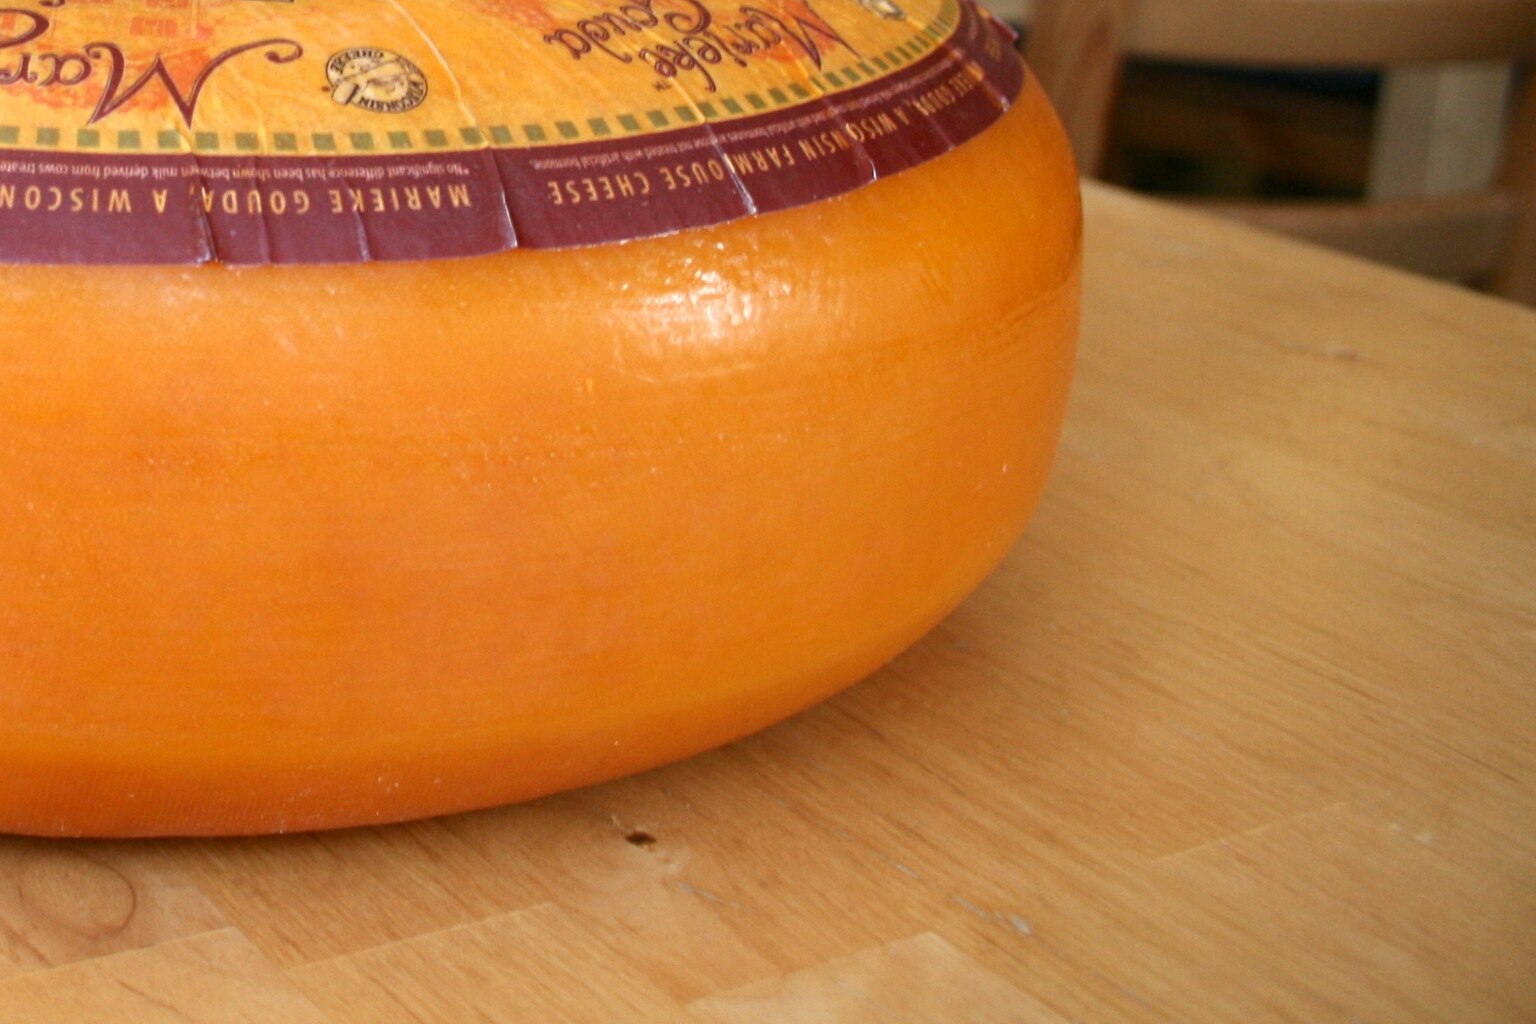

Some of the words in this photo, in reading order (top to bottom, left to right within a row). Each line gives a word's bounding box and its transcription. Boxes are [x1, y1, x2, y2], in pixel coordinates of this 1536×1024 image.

[38, 163, 69, 176] cows
[71, 164, 101, 180] from
[103, 164, 149, 180] derived
[151, 166, 178, 181] milk
[232, 167, 271, 182] shown
[272, 167, 305, 182] been
[304, 167, 327, 182] has
[328, 166, 385, 182] difference
[387, 160, 445, 180] significant
[658, 144, 796, 191] FARMOUSE
[547, 172, 651, 205] CHEESE
[151, 187, 169, 215] A
[189, 183, 311, 215] GOUDA,
[328, 183, 472, 214] MARIEKE
